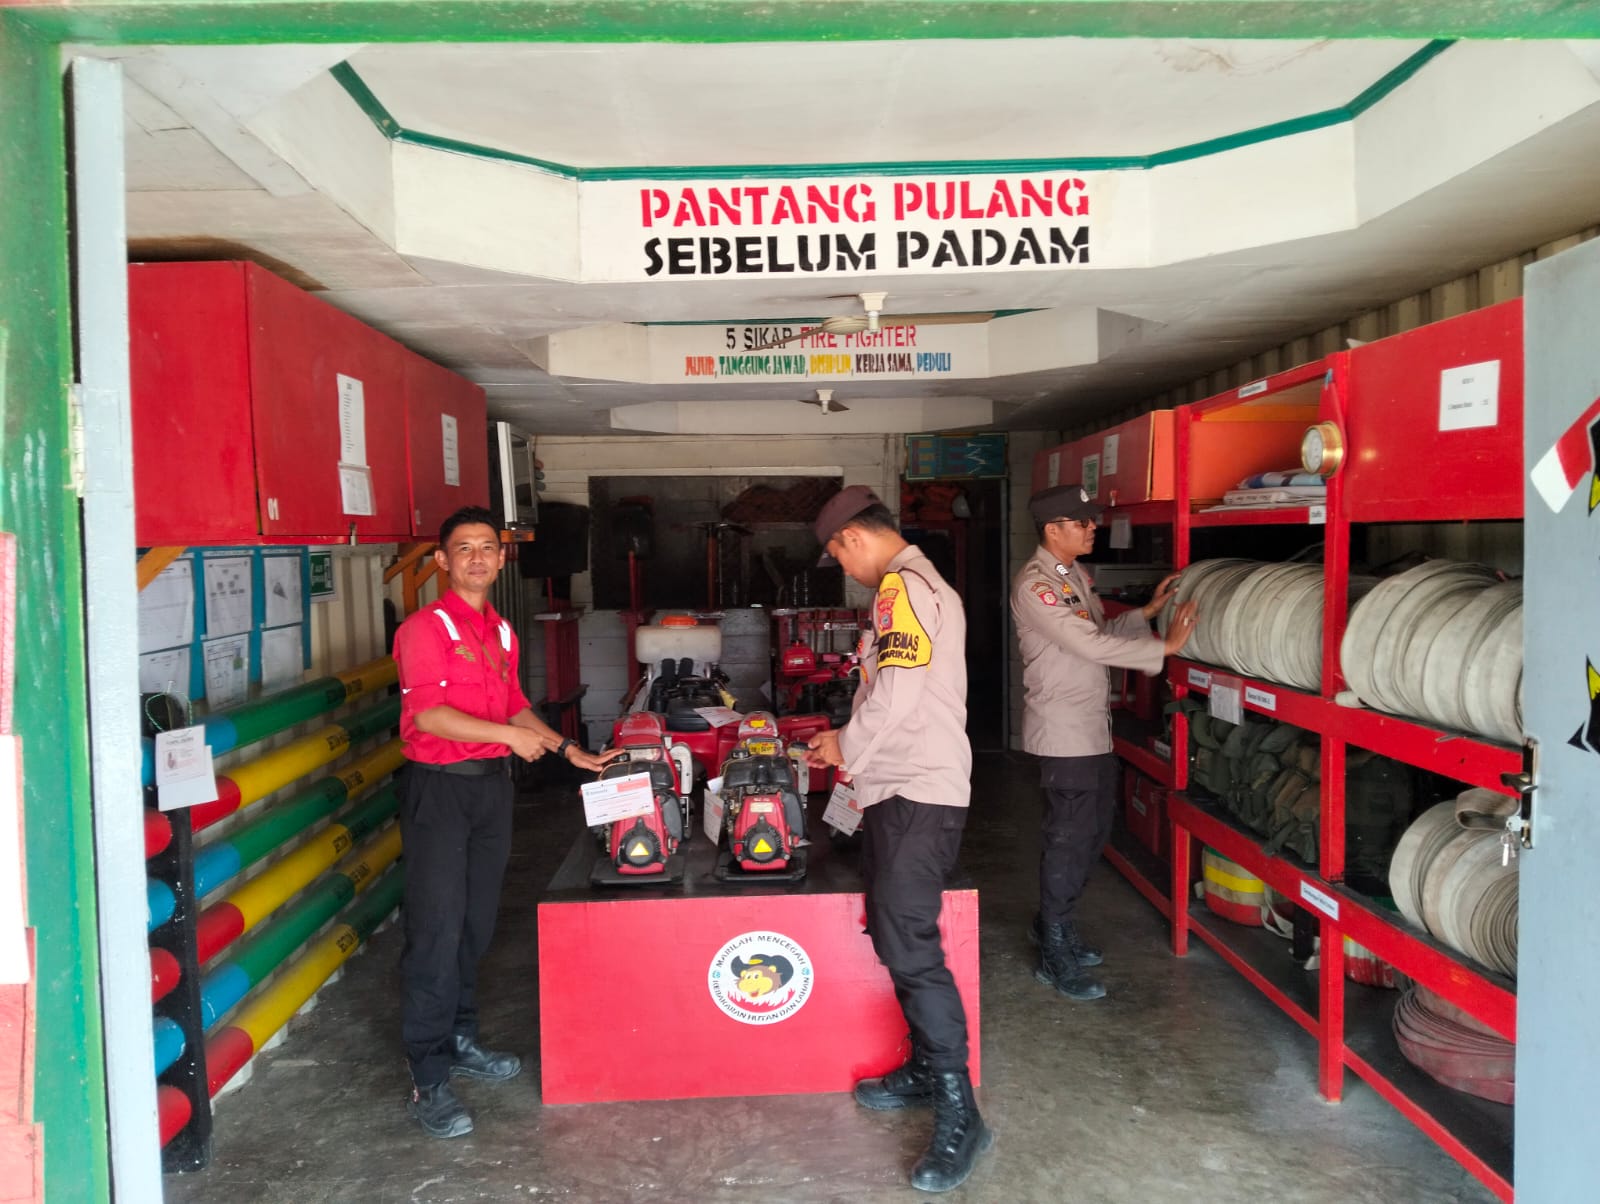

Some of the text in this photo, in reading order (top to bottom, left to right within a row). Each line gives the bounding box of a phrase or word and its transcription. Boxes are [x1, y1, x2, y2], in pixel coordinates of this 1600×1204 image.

[641, 178, 1089, 227] PANTANG PULANG
[644, 226, 1090, 276] SEBELUM PADAM
[726, 325, 916, 349] 5 SIKAP FIRE FIGHTER
[719, 356, 769, 375] TANGGUNG
[772, 354, 808, 378] JAWAB,
[856, 353, 885, 373] KERJA
[887, 352, 914, 375] SAMA,
[917, 352, 951, 372] PEDULI
[715, 935, 806, 968] MARILAH MENCEGAH
[712, 976, 810, 1022] KEBAKARAN HUTAN DAN LAHAN
